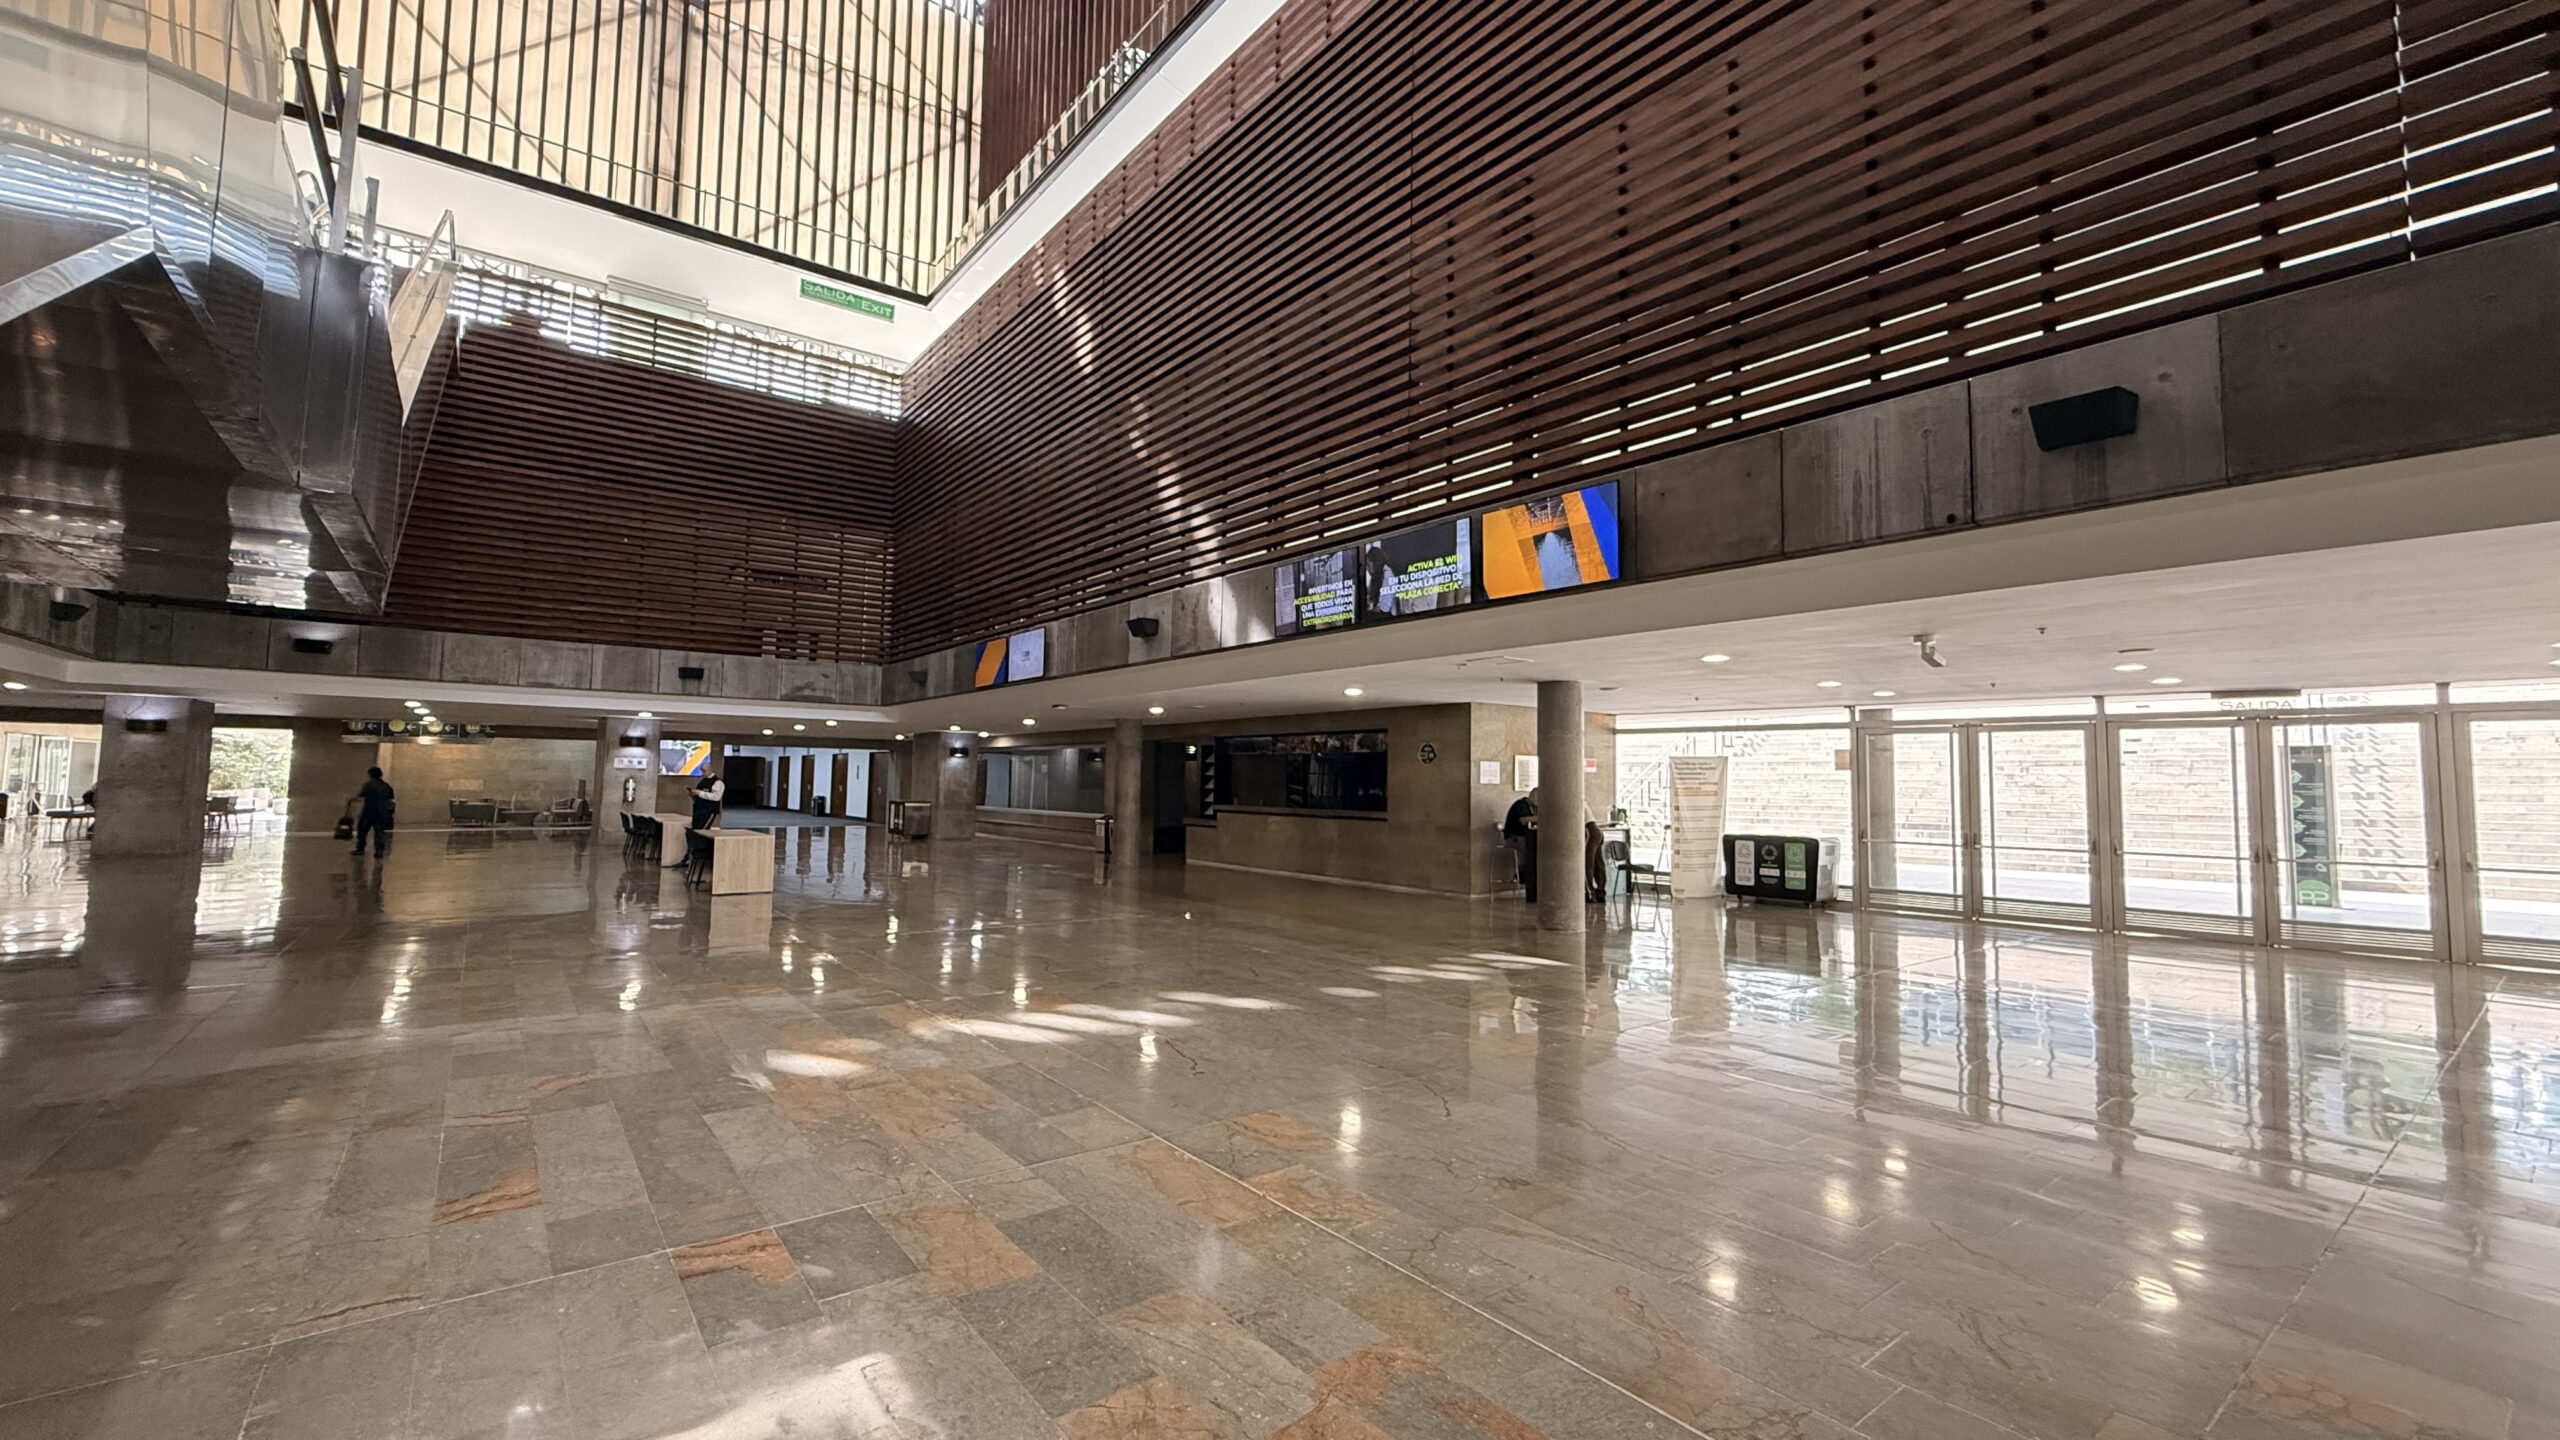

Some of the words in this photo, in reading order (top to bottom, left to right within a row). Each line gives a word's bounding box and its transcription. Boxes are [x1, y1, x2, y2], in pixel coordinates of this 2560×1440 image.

[803, 280, 855, 303] SALIDA
[861, 300, 892, 317] EXIT
[1407, 560, 1434, 573] ACTIVA
[1434, 557, 1444, 566] EL
[1388, 576, 1399, 585] EN
[1400, 574, 1409, 583] TU
[1410, 563, 1457, 581] DISPOSITIVO
[1344, 579, 1353, 588] EN
[1380, 581, 1424, 596] SELECCIONA
[1424, 579, 1434, 589] LA
[1435, 575, 1451, 587] RED
[1452, 571, 1464, 581] DE
[1336, 587, 1353, 597] PARA
[1301, 603, 1313, 612] QUE
[1314, 599, 1334, 609] TODOS
[1334, 595, 1353, 606] VIVAN
[1302, 611, 1315, 619] UNA
[2219, 699, 2294, 711] SALIDA
